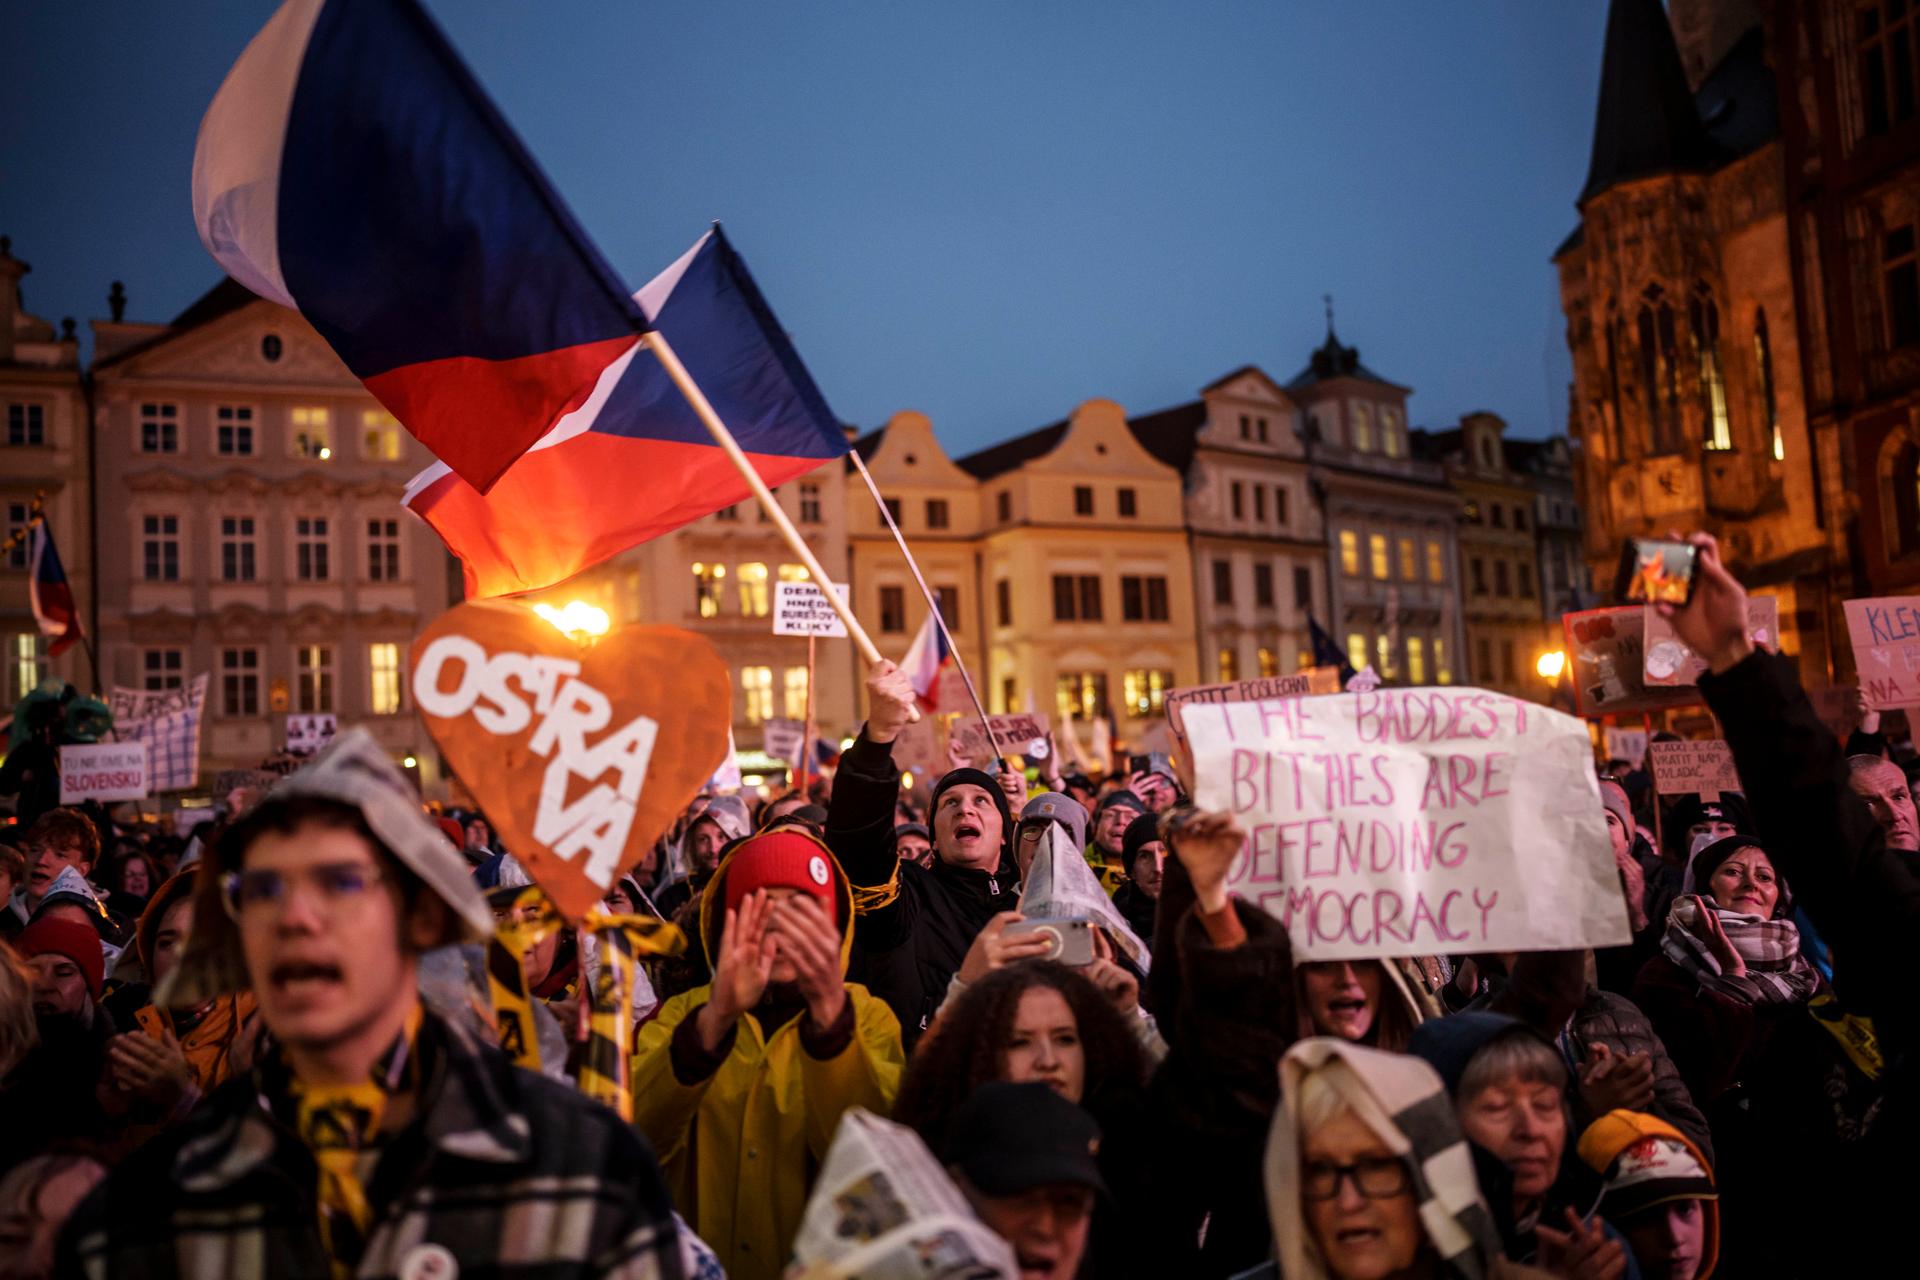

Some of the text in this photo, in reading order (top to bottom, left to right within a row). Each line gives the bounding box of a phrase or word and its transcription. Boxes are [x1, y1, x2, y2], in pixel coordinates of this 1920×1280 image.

[1869, 676, 1905, 703] NA
[1355, 691, 1529, 746] BADDEST
[127, 753, 143, 766] NA
[64, 770, 142, 792] SLOVENSKU
[1418, 752, 1512, 811] ARE
